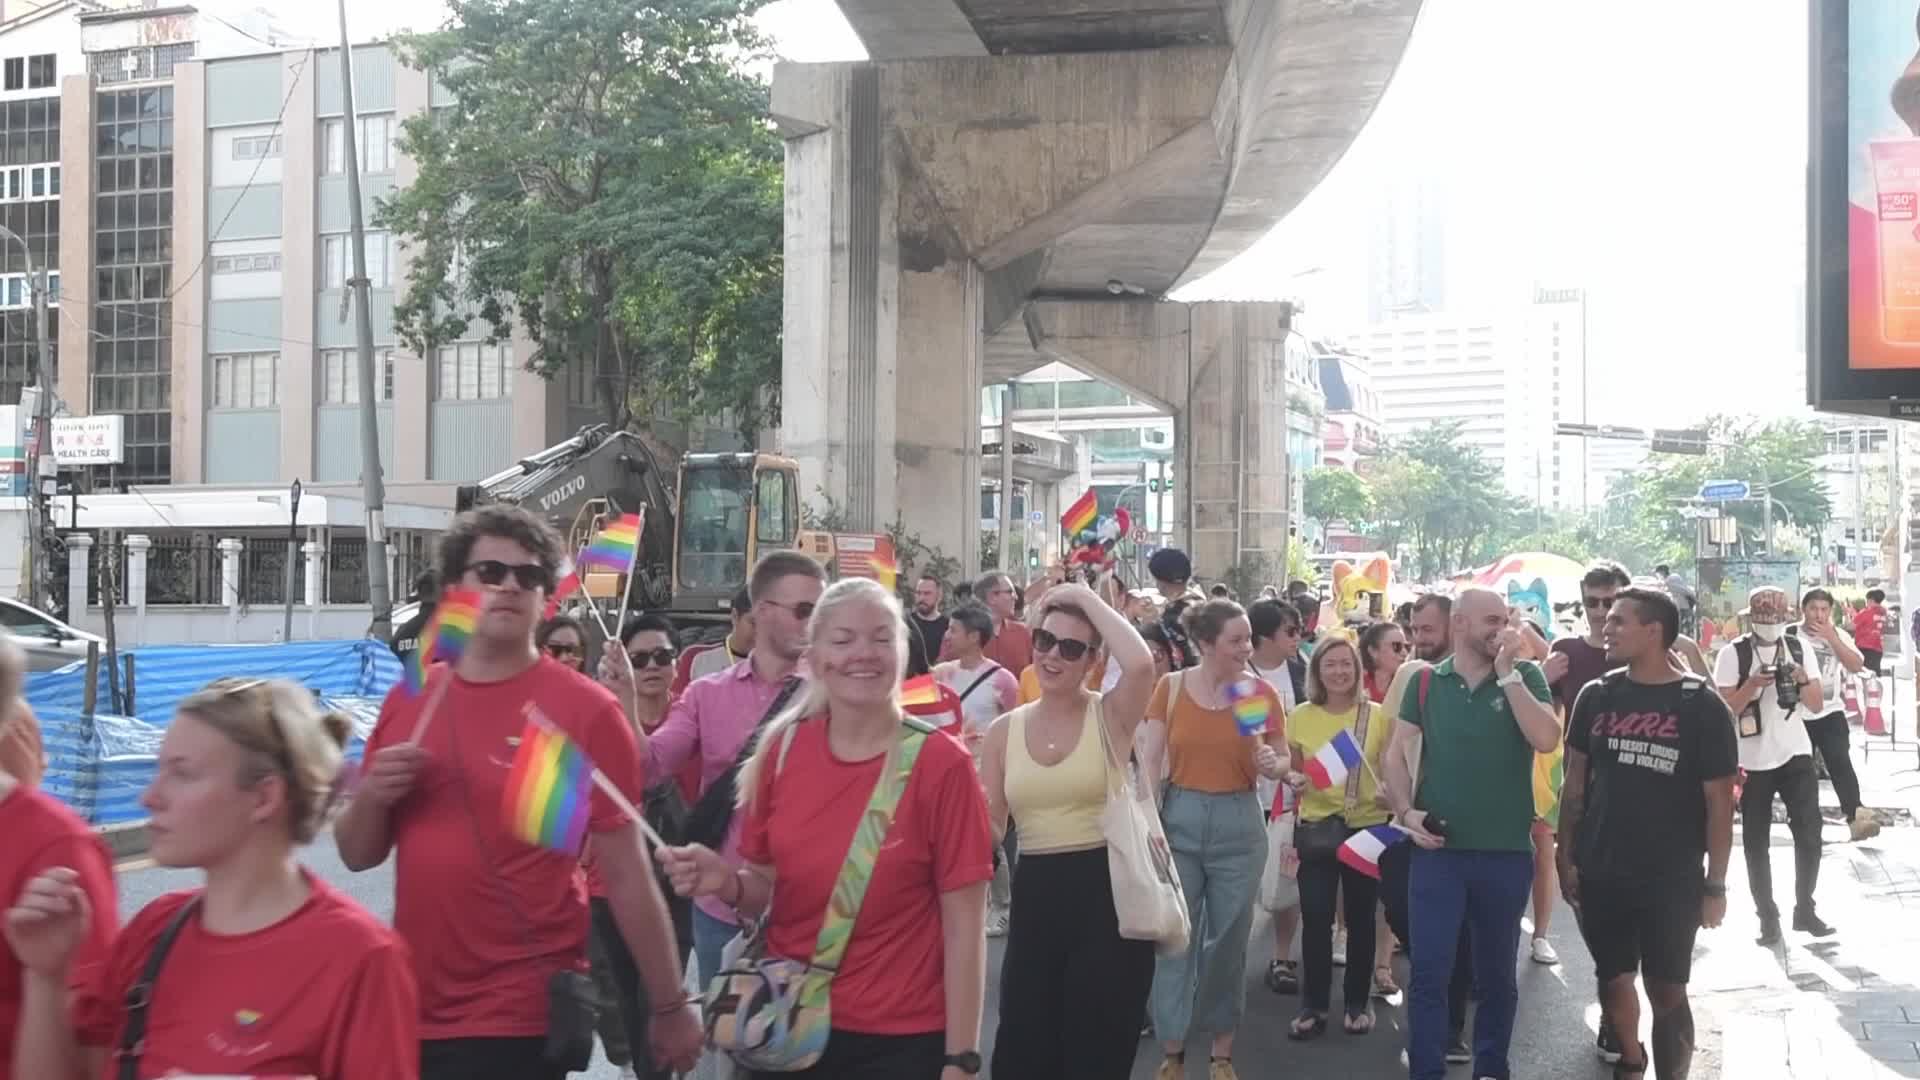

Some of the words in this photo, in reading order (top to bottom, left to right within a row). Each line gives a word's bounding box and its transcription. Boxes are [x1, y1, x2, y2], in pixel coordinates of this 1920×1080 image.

[58, 449, 87, 457] HEALTH
[540, 475, 585, 511] VOLVO
[398, 638, 419, 651] GUA
[1608, 738, 1619, 750] TO
[1620, 739, 1649, 754] RESIST
[1650, 743, 1679, 761] DRUGS
[1617, 752, 1635, 765] AND
[1637, 754, 1676, 773] VIOLENCE
